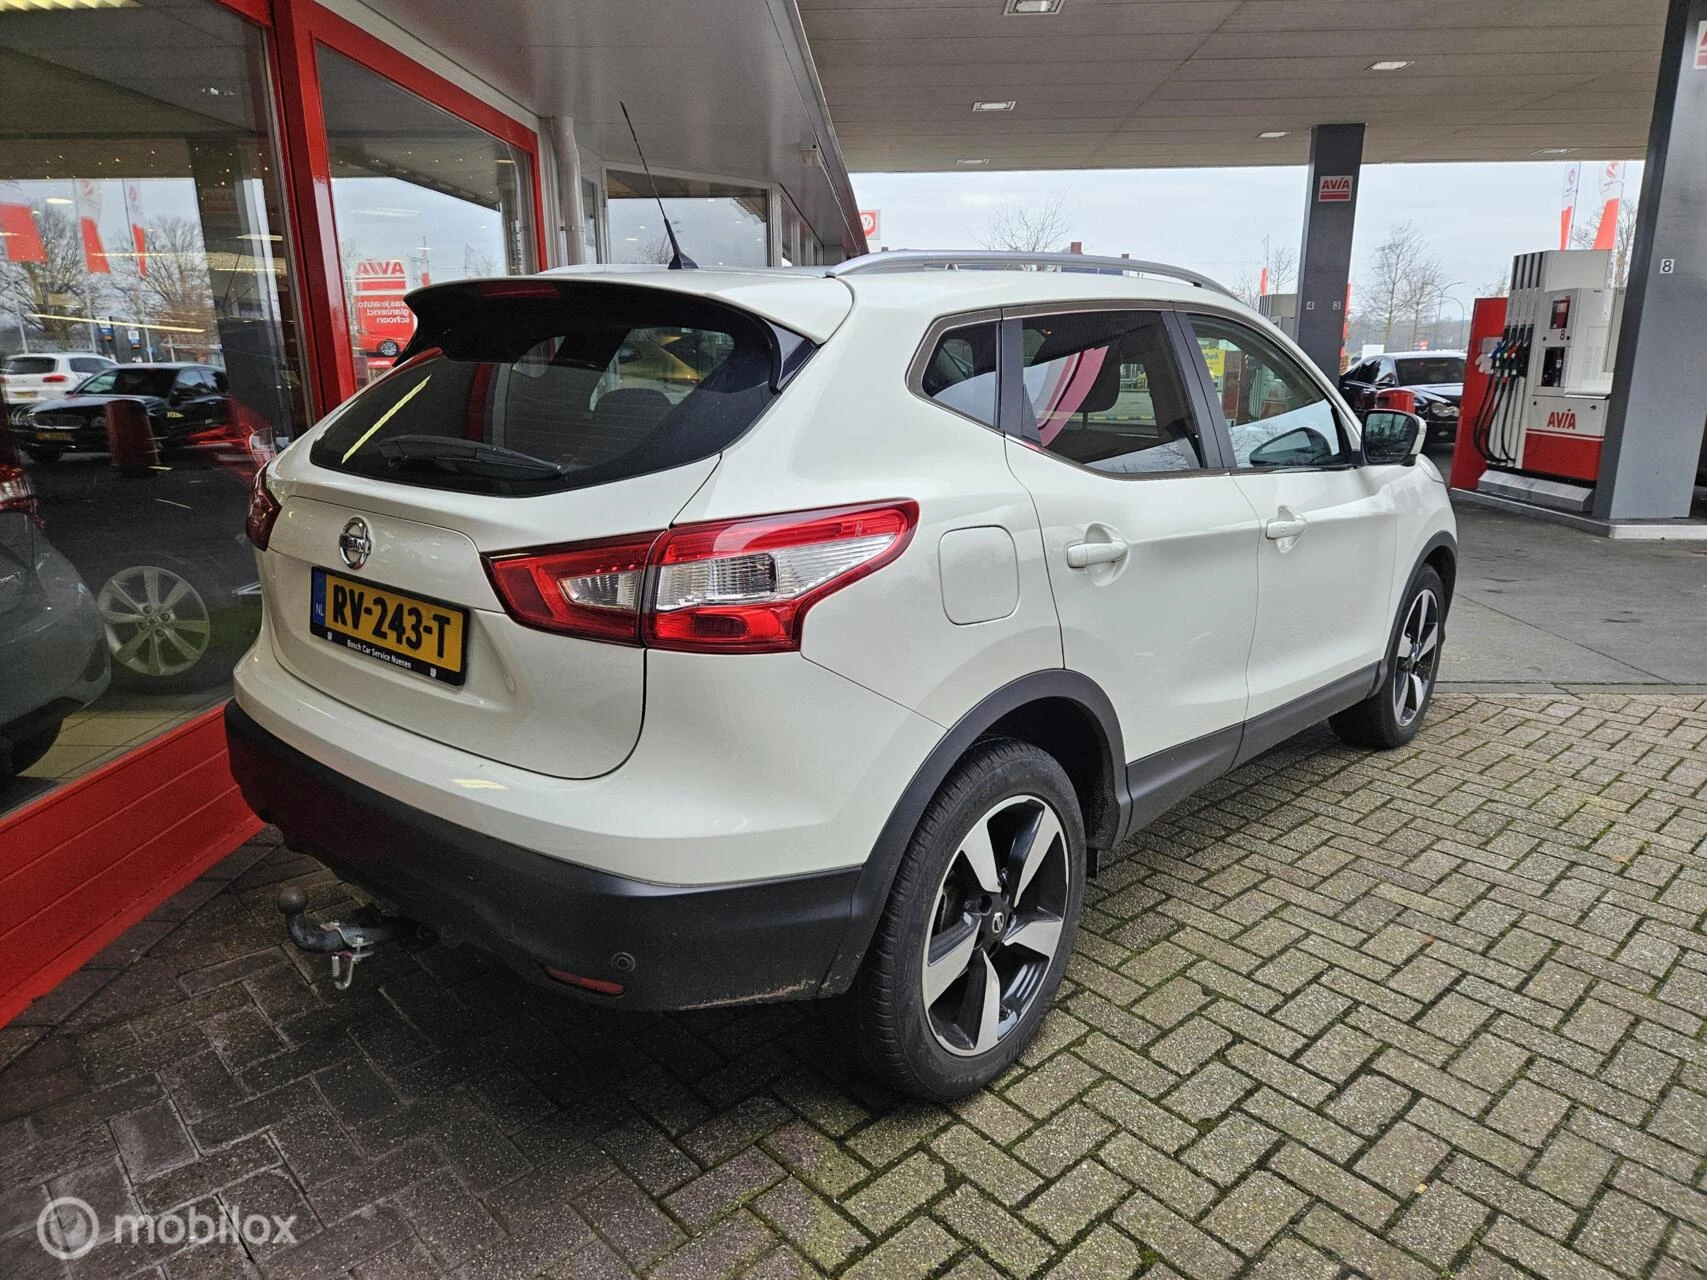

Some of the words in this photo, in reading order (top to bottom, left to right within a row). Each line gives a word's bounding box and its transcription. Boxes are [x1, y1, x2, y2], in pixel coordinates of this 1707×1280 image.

[1662, 259, 1672, 273] 8
[1560, 329, 1566, 341] 8
[1546, 408, 1577, 430] AVIA
[315, 602, 325, 617] NL
[333, 584, 450, 659] RV-243-T
[346, 639, 362, 652] Bosch
[362, 644, 371, 654] Car
[371, 648, 391, 662] Service
